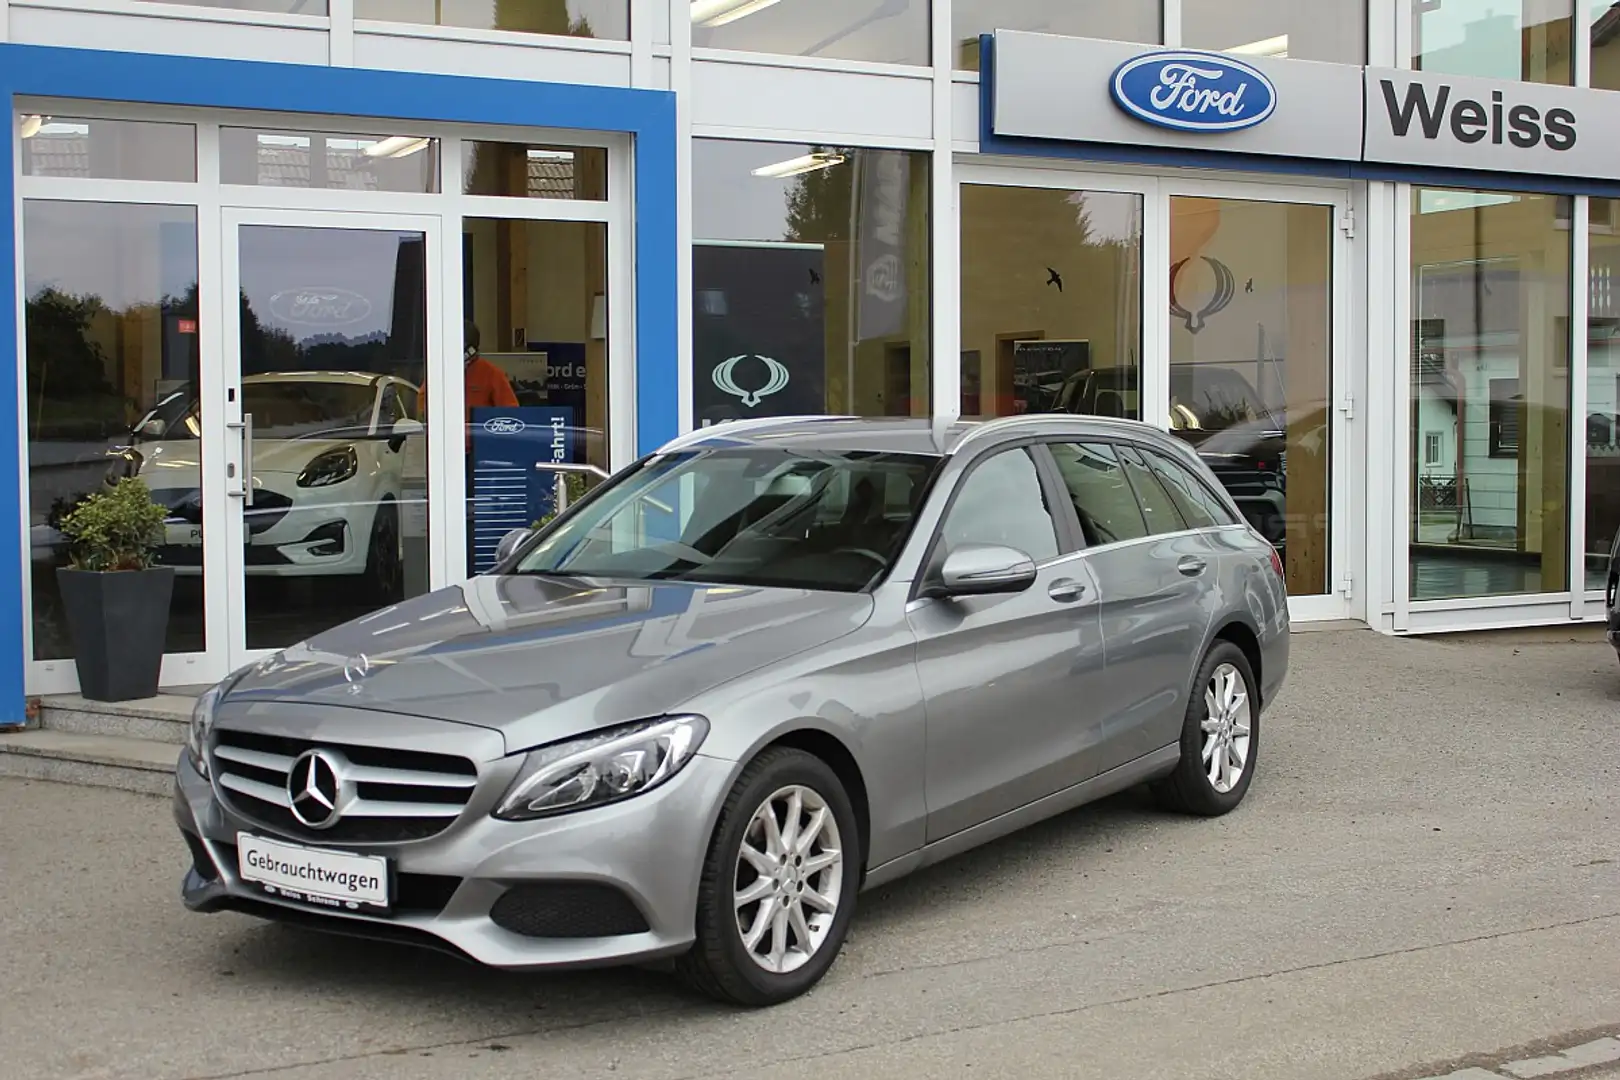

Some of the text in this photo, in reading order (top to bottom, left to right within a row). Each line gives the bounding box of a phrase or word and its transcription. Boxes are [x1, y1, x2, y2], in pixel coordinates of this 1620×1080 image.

[1149, 63, 1247, 116] Ford
[1379, 79, 1577, 152] Weiss
[490, 419, 519, 432] Ford
[247, 849, 378, 891] Gebrauchtwagen
